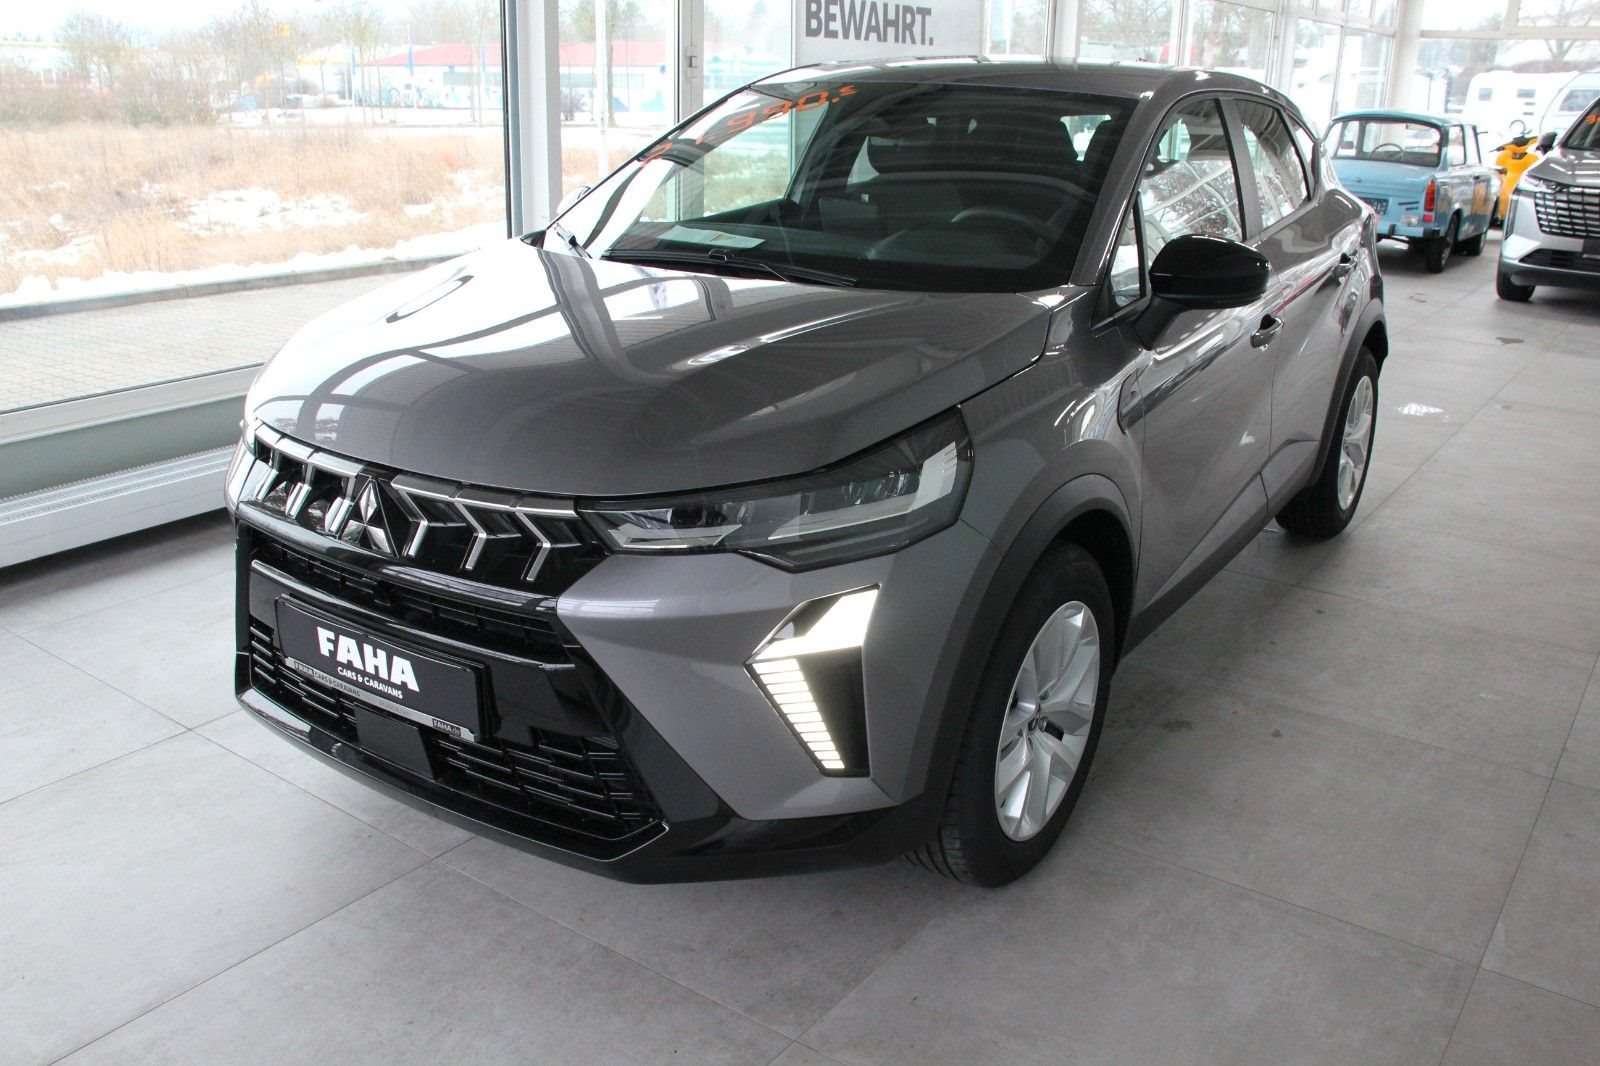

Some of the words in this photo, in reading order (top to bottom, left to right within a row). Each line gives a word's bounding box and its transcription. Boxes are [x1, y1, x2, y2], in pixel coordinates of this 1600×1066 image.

[805, 0, 933, 46] BEWAHRT.
[317, 626, 420, 692] FAHA
[337, 666, 357, 681] CARS
[357, 675, 363, 684] &
[364, 676, 404, 699] CARAVANS
